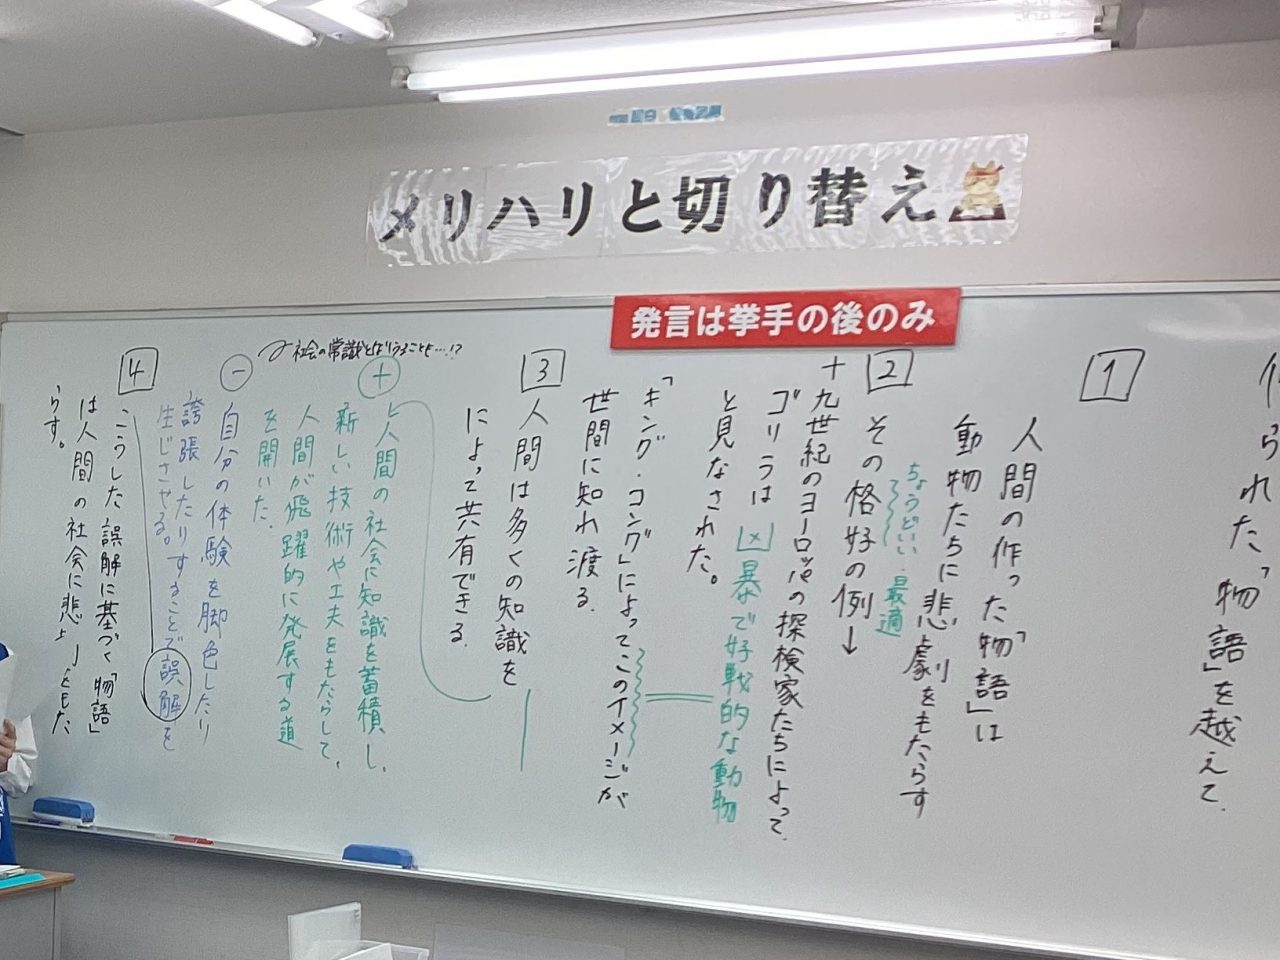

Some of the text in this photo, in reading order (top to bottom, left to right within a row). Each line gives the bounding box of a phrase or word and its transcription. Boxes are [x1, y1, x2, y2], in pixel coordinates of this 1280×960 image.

[379, 163, 937, 242] メリハリと切り替え
[631, 300, 936, 338] 発言は挙手の後のみ
[494, 397, 549, 686] 人間は多くの知識を
[899, 413, 983, 819] 動物たちに悲劇をもたらす
[965, 416, 1043, 743] 人間の作った「物語」は
